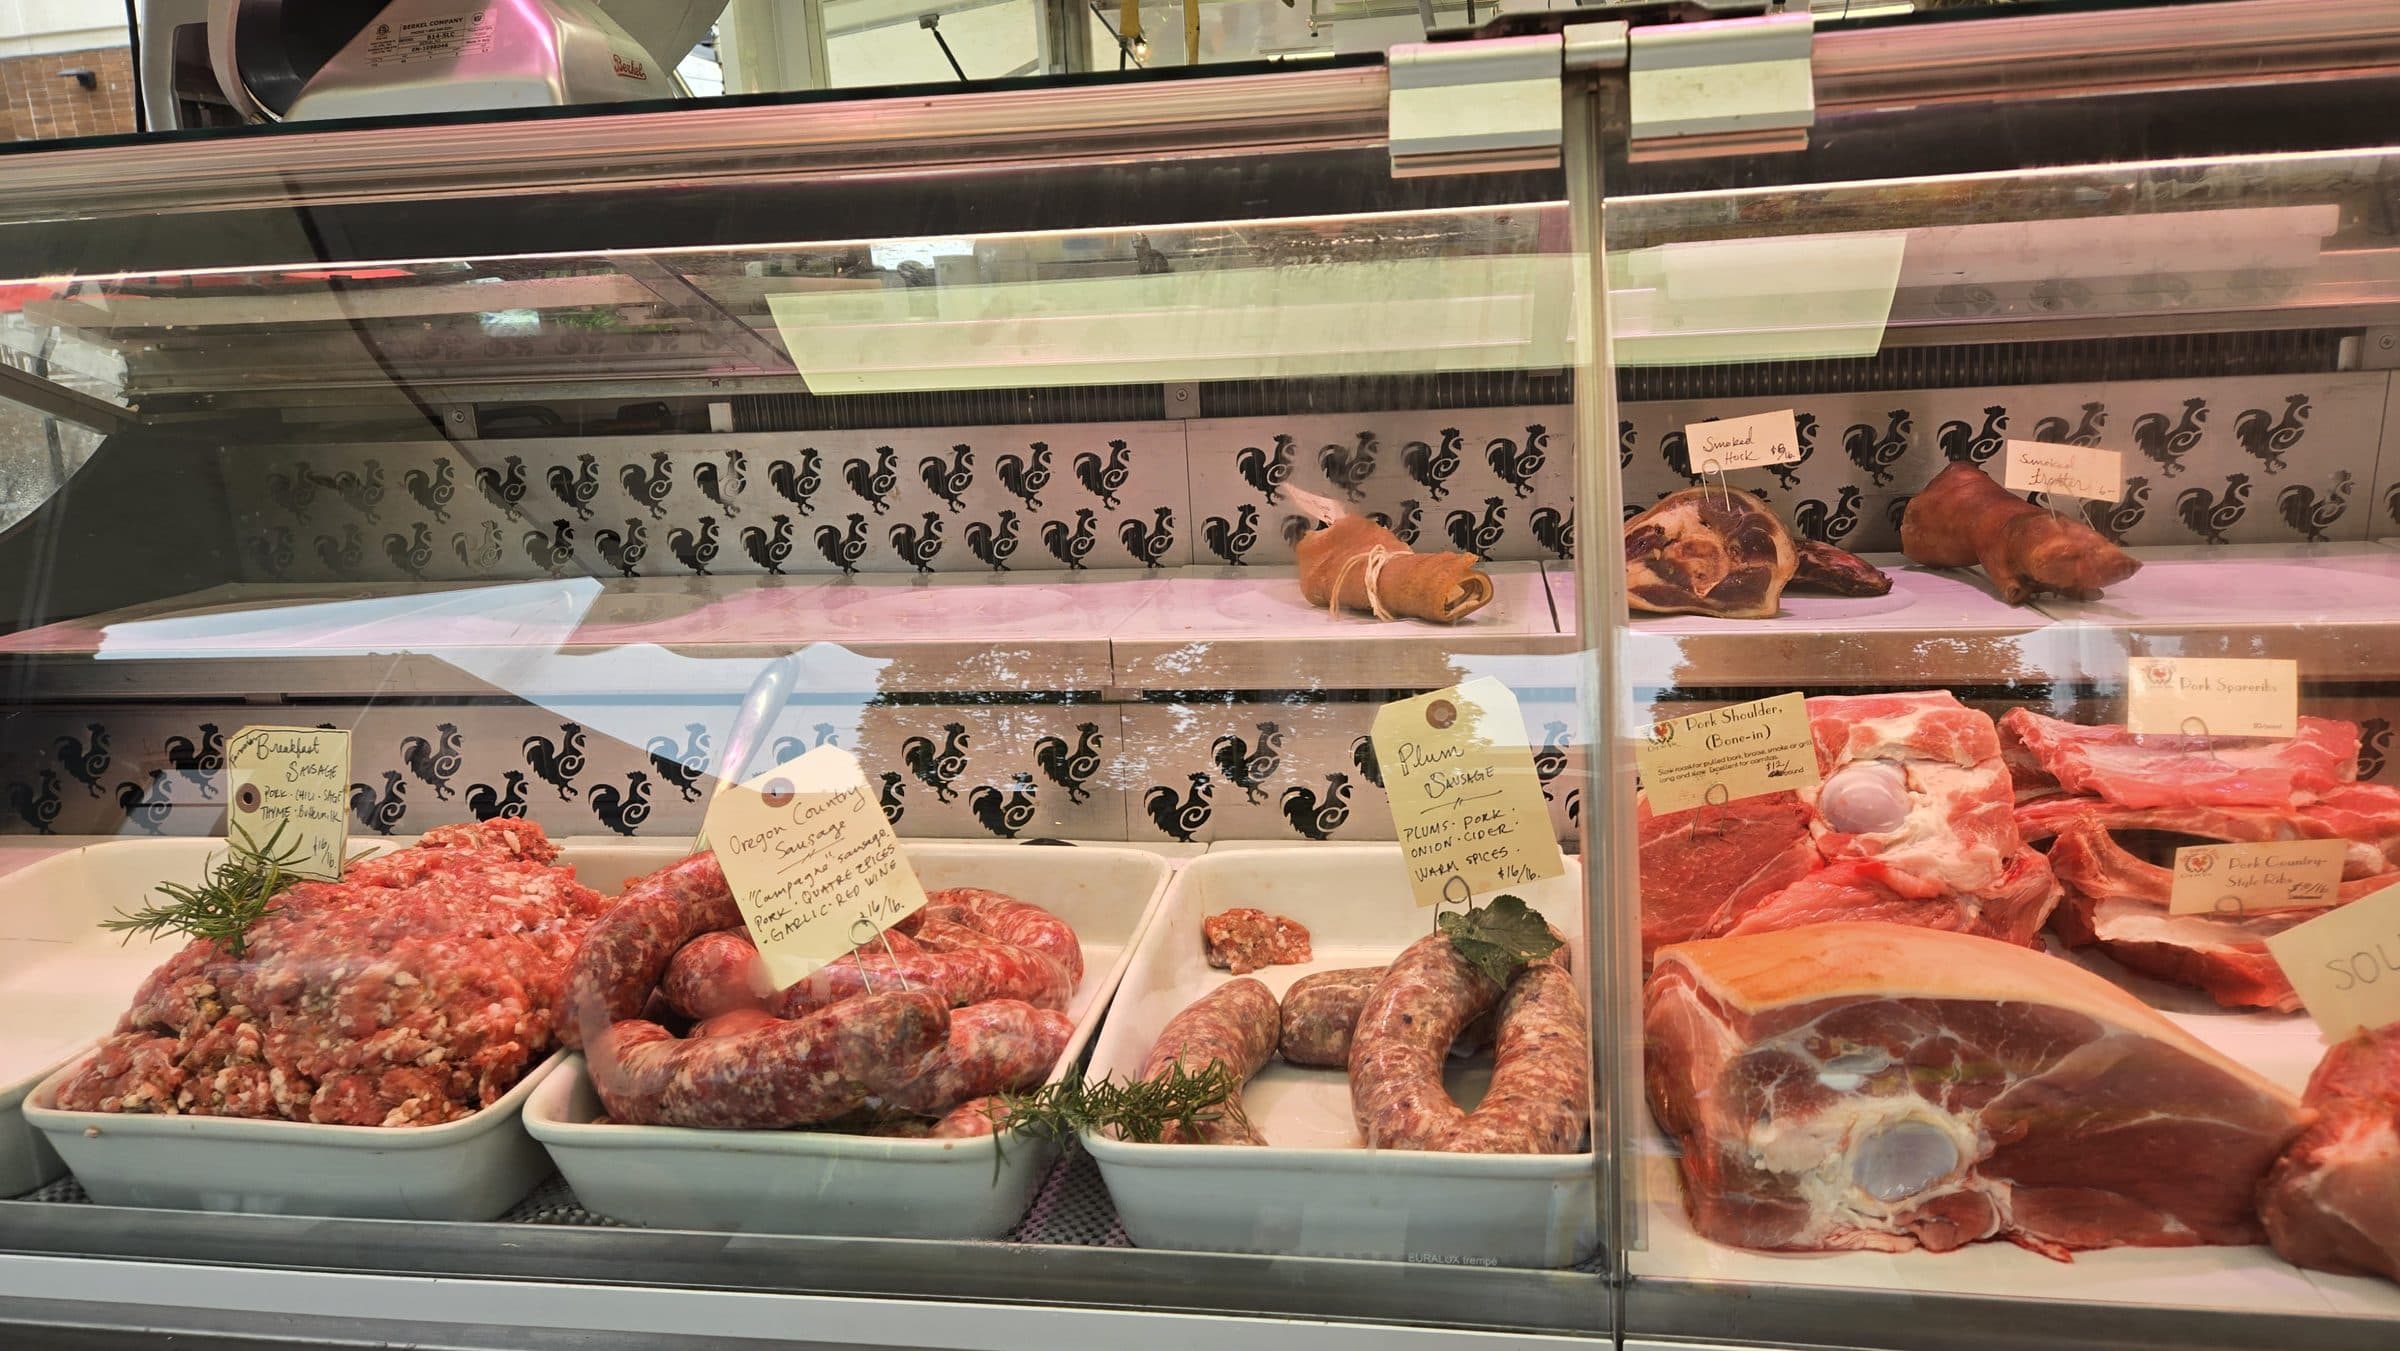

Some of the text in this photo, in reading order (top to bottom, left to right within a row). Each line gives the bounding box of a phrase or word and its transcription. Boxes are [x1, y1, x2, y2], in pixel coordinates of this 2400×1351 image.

[402, 17, 463, 30] BERKEL COMPANY
[1703, 426, 1754, 452] Smoked
[2020, 453, 2076, 469] Smoked
[2180, 676, 2278, 694] Pork Spareribs
[1686, 701, 1783, 731] Pork Shoulder,
[256, 733, 320, 760] Breakfast
[1705, 723, 1771, 750] (Bone-in)
[1398, 742, 1465, 777] Plum
[260, 805, 292, 821] THYME
[729, 785, 866, 856] Oregon Country
[1464, 808, 1506, 830] PORK
[775, 820, 846, 860] Sausage
[1411, 837, 1452, 858] ONION
[1415, 860, 1459, 882] WARM
[2228, 855, 2328, 870] Pork Country-
[2225, 872, 2293, 889] Style Ribs
[754, 908, 792, 933] PORK
[802, 870, 852, 905] QUATRE
[770, 860, 897, 943] GARLIC RED WINE
[2326, 934, 2400, 990] SOL
